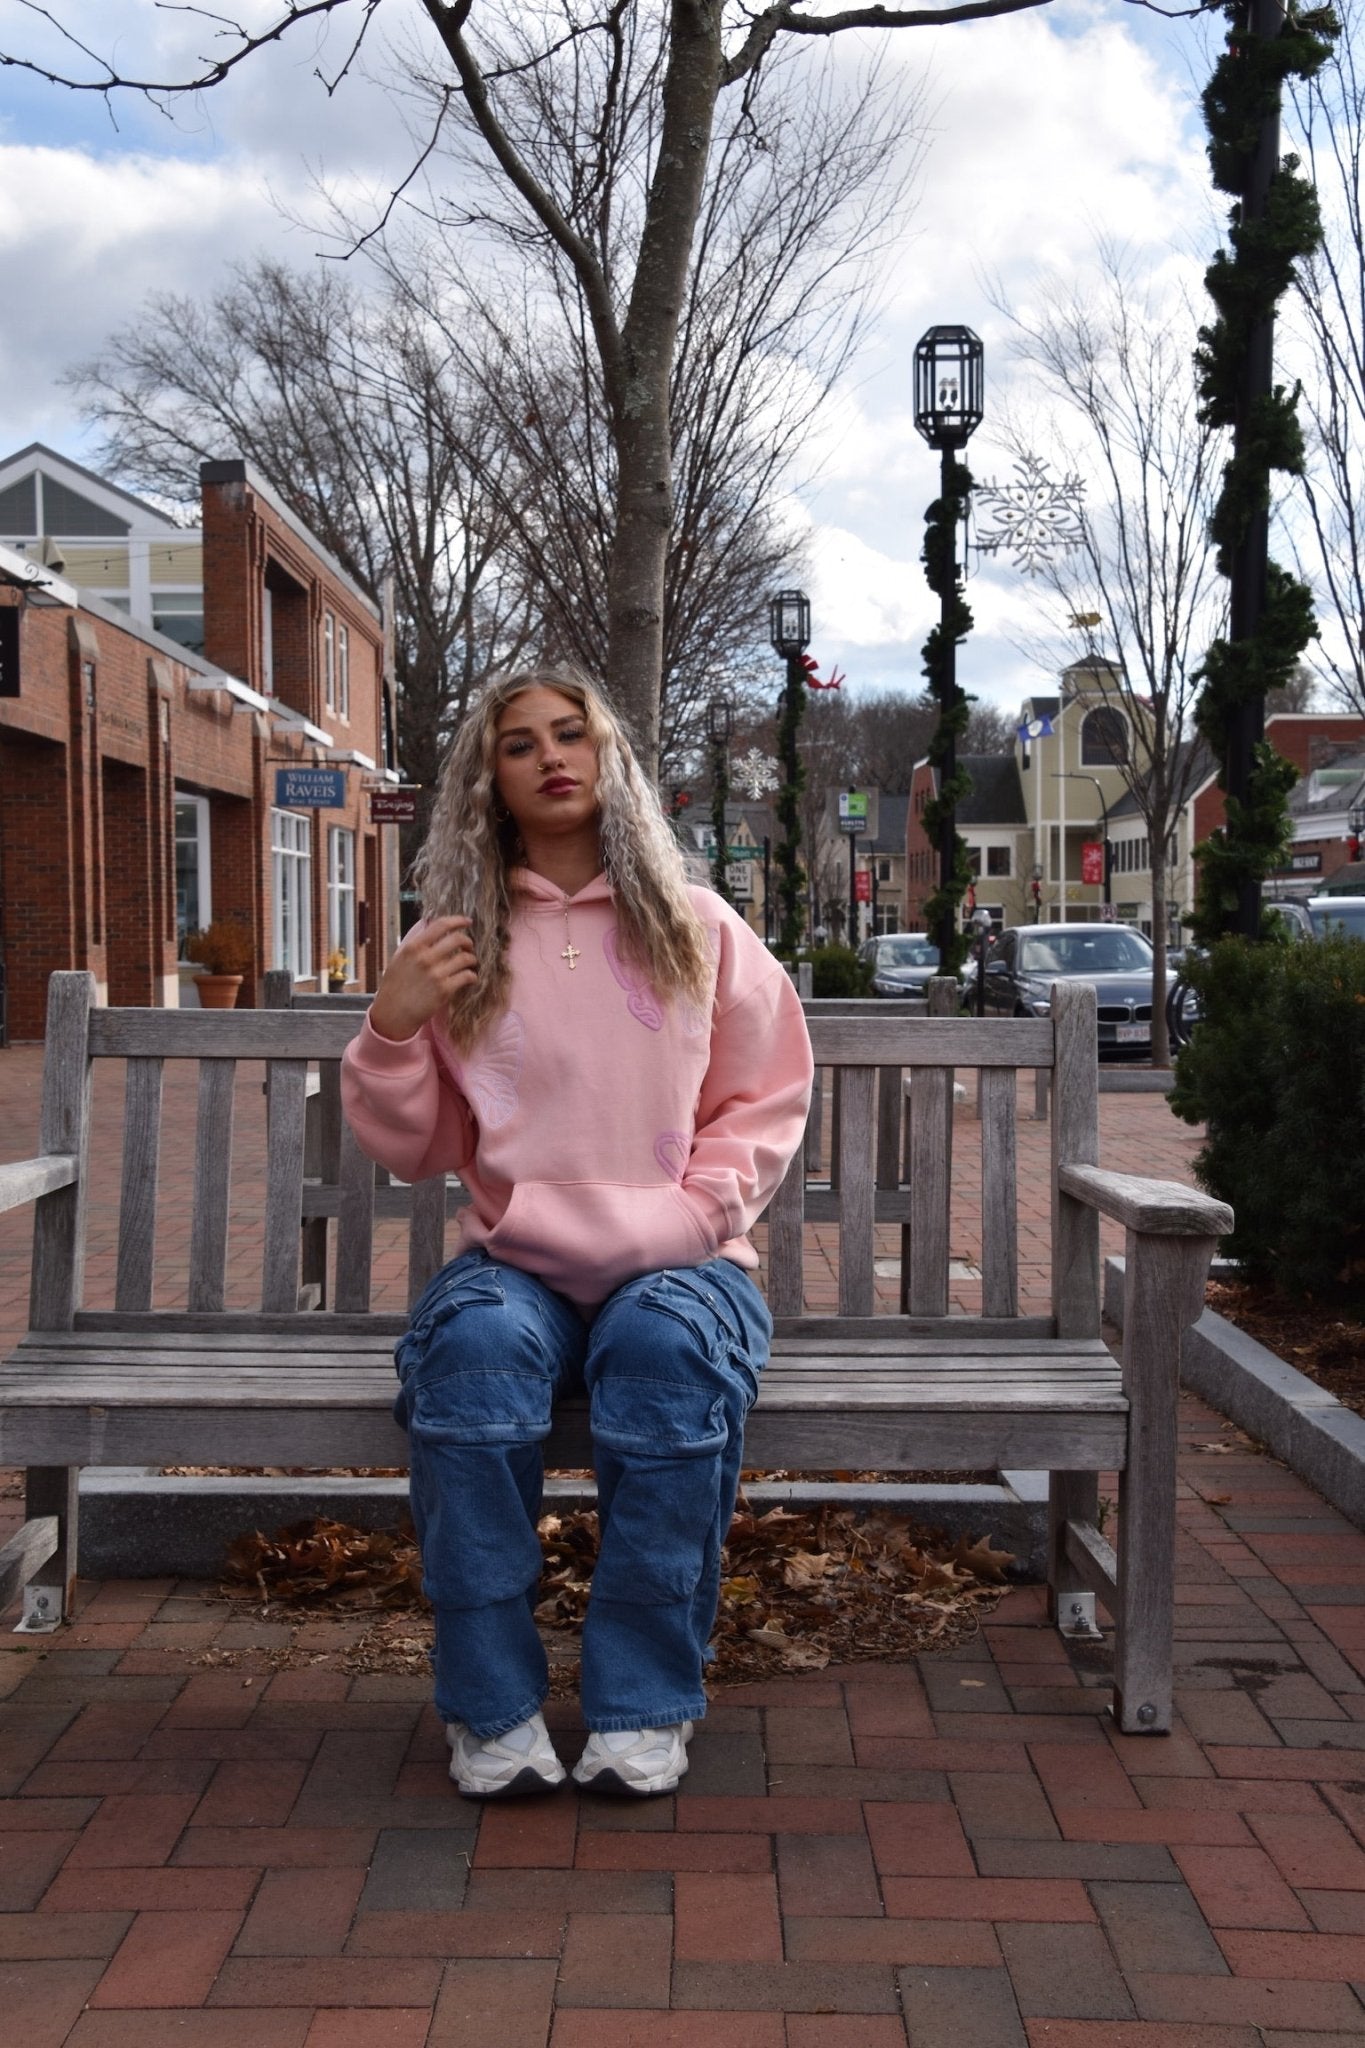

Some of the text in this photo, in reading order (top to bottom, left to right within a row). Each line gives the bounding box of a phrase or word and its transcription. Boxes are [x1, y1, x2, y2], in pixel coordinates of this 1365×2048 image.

[287, 772, 334, 783] WILLIAM
[285, 783, 336, 797] RAVEIS
[729, 865, 747, 874] ONE
[729, 875, 748, 883] WAY
